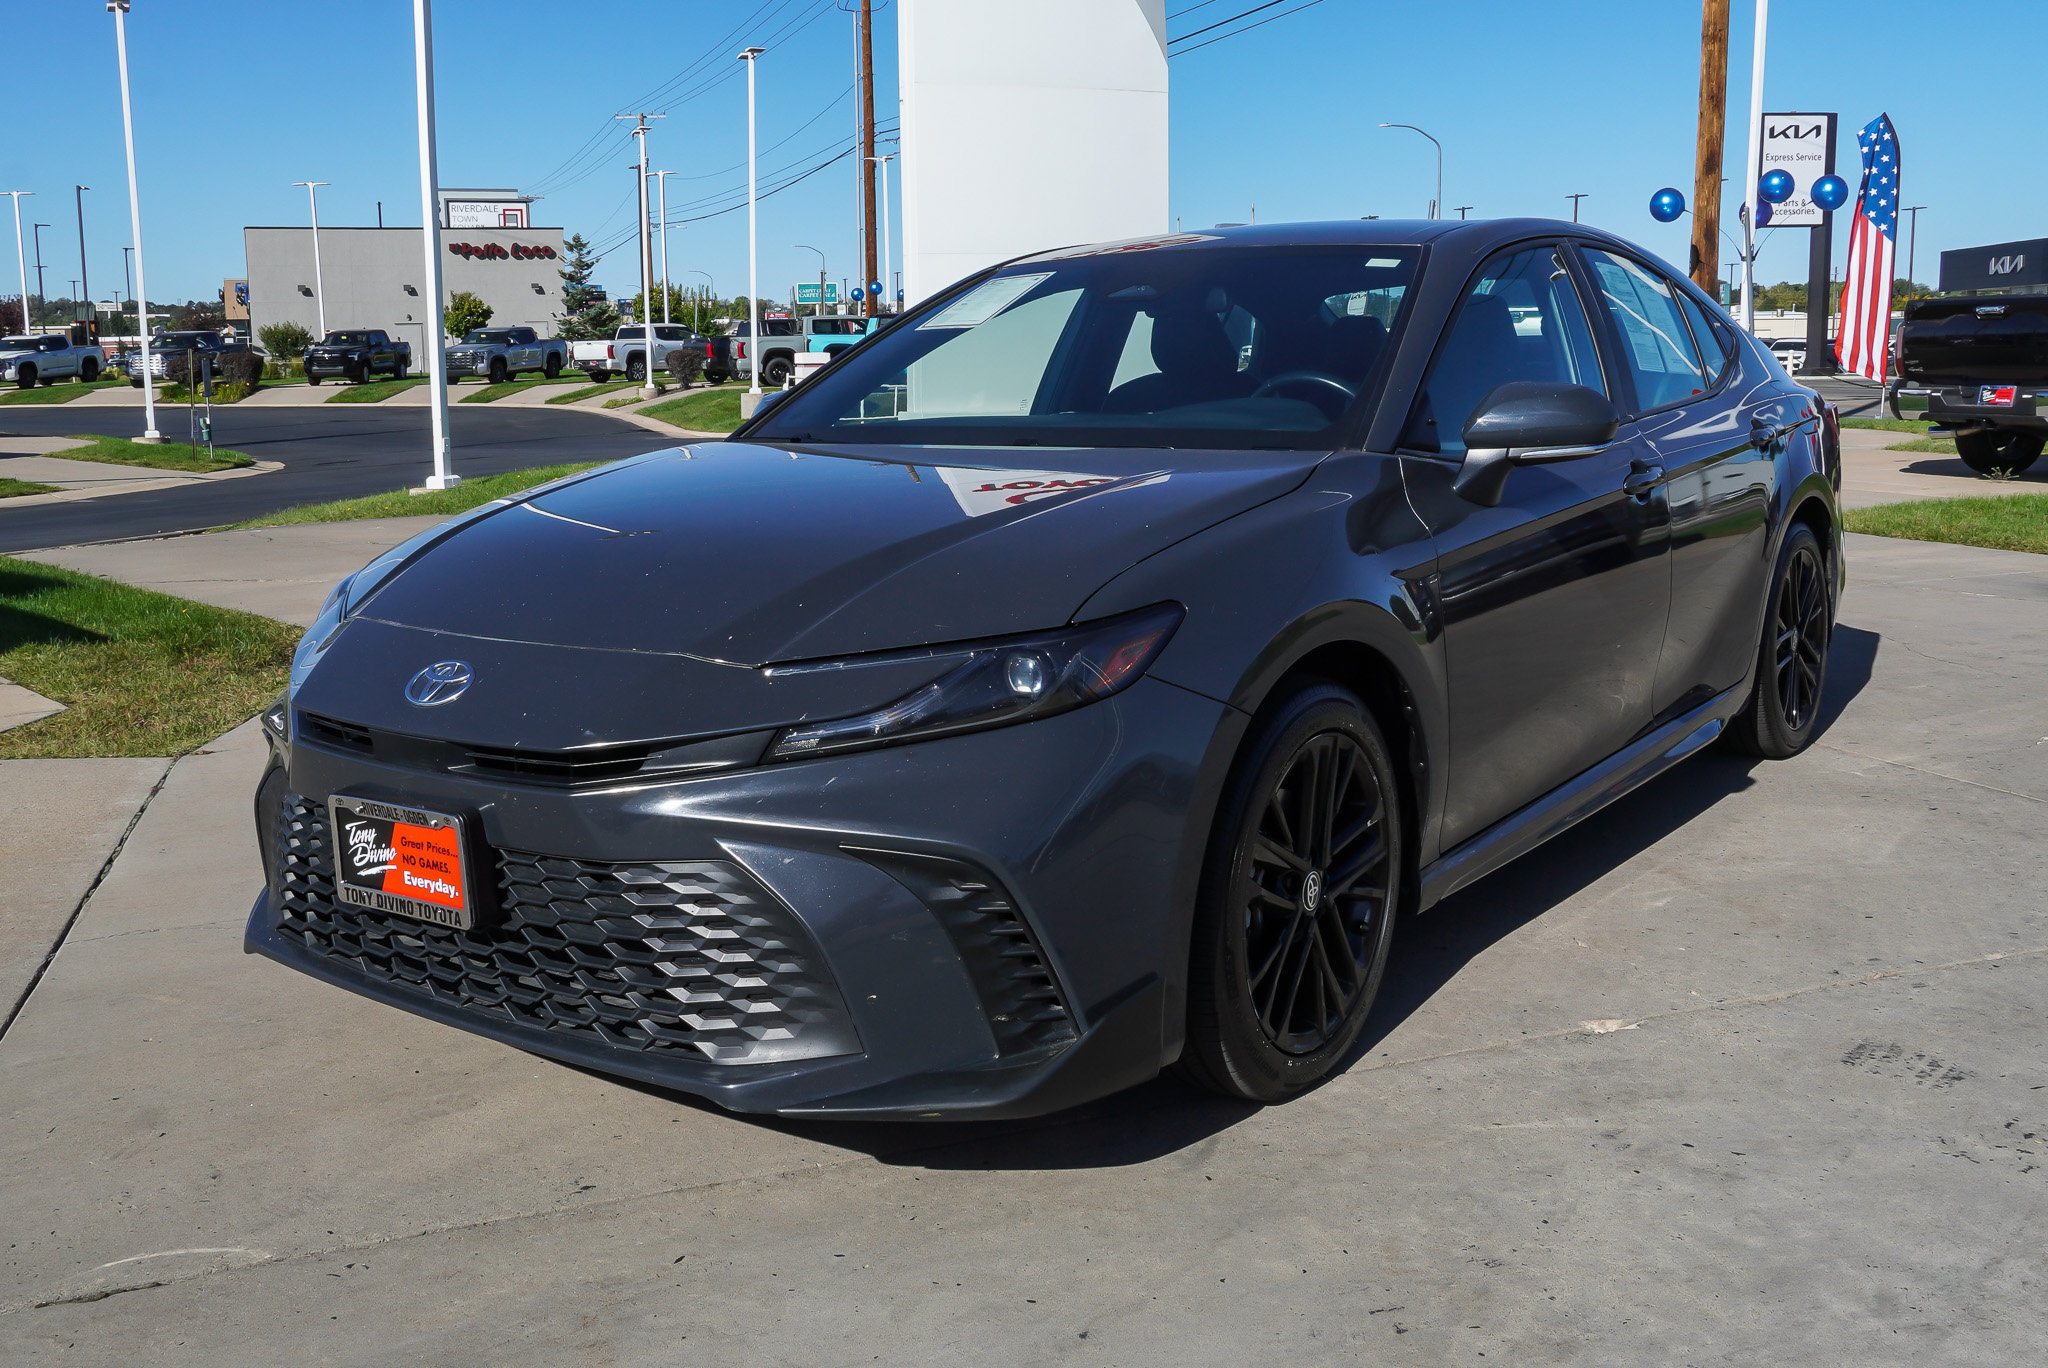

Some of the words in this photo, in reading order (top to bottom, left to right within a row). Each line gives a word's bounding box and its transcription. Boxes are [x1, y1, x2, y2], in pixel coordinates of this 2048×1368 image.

[1769, 125, 1821, 139] KIA
[1765, 153, 1794, 162] Express
[1796, 153, 1822, 161] Service
[451, 205, 499, 213] RIVERDALE
[1772, 207, 1815, 216] ccessories
[1801, 199, 1807, 207] &
[452, 215, 478, 223] TOWN
[460, 243, 509, 260] Pollo
[511, 243, 557, 260] Loco
[1989, 254, 2024, 275] KIA
[361, 801, 400, 821] RIVERDALE
[345, 820, 377, 849] Tony
[348, 843, 398, 867] Divino
[400, 836, 425, 850] Great
[426, 842, 459, 858] Prices...
[402, 854, 417, 866] NO
[419, 857, 452, 875] GAMES.
[403, 870, 459, 899] Everyday.
[344, 887, 374, 906] TONY
[377, 892, 414, 916] DIVINO
[417, 901, 462, 927] TOYOTA
